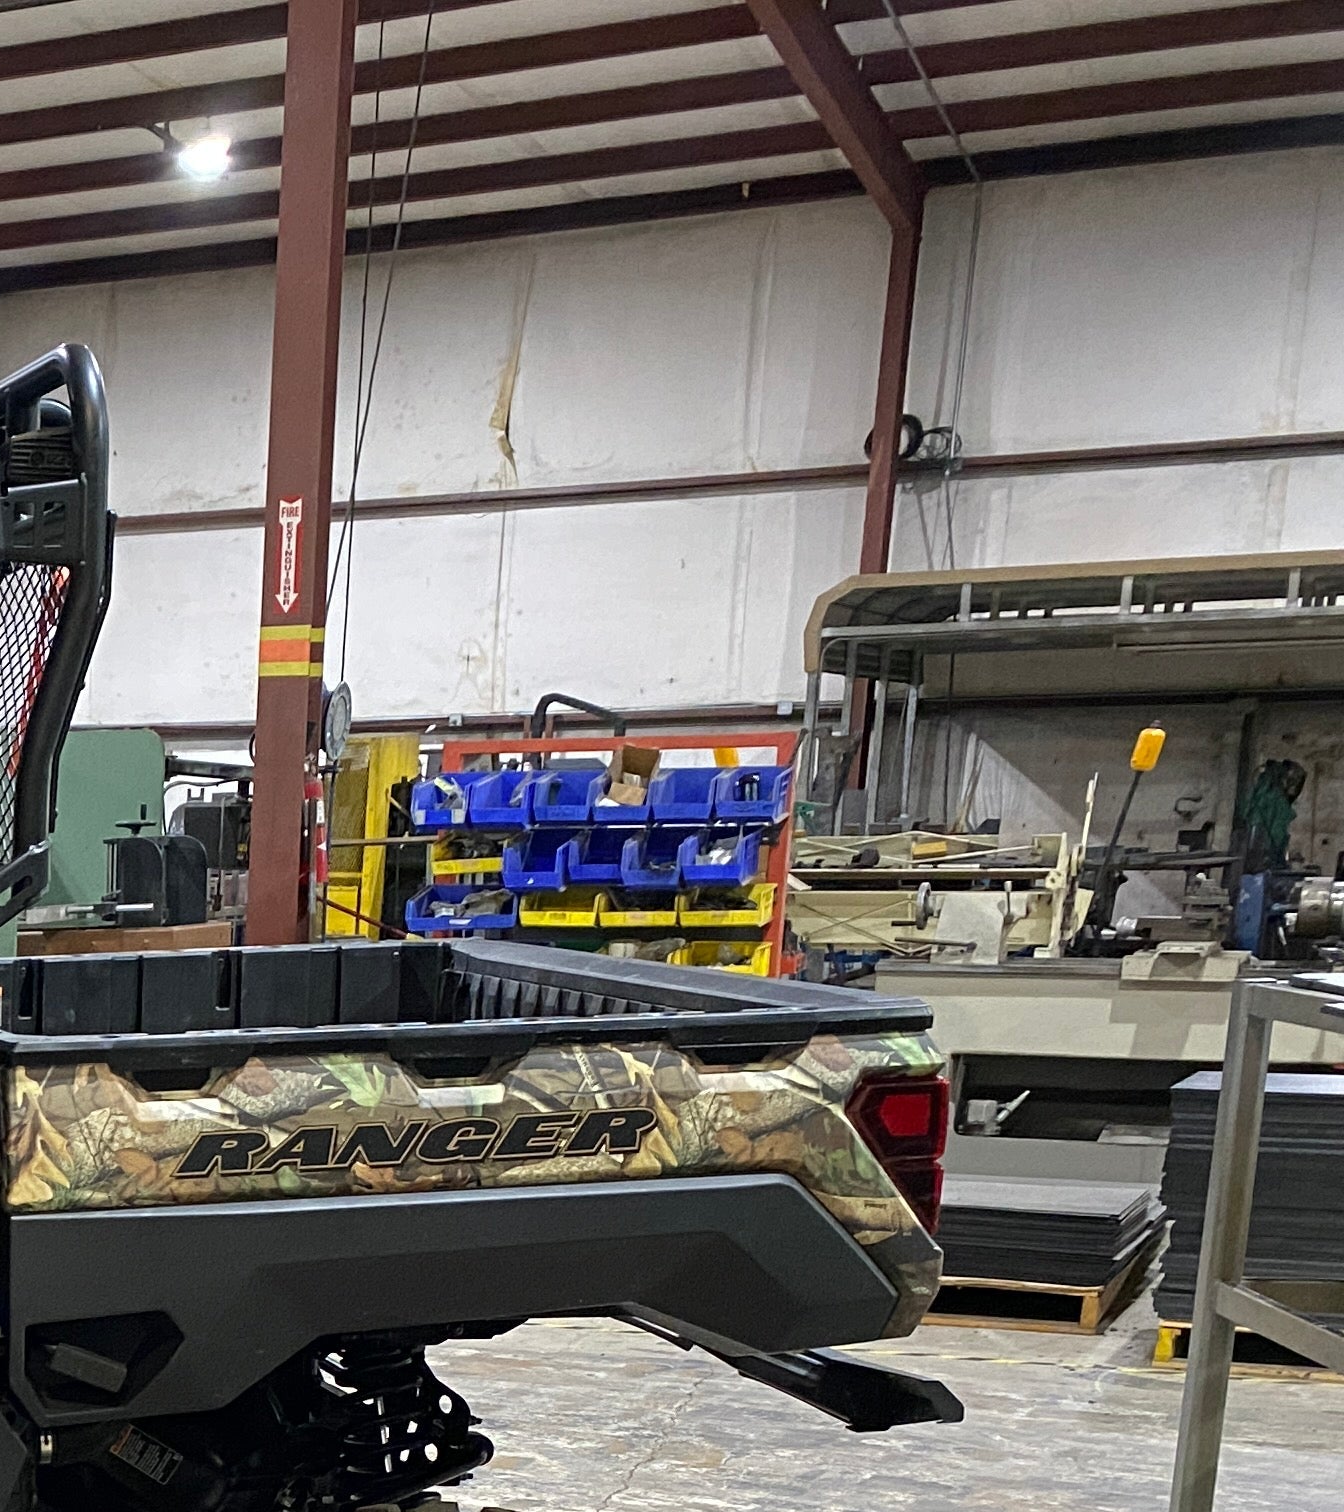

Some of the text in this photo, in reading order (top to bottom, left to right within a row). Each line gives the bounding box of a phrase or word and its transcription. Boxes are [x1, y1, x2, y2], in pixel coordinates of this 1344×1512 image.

[280, 506, 300, 518] FIRE
[282, 521, 294, 606] EXTINGUISHER
[170, 1107, 659, 1178] RANGER
